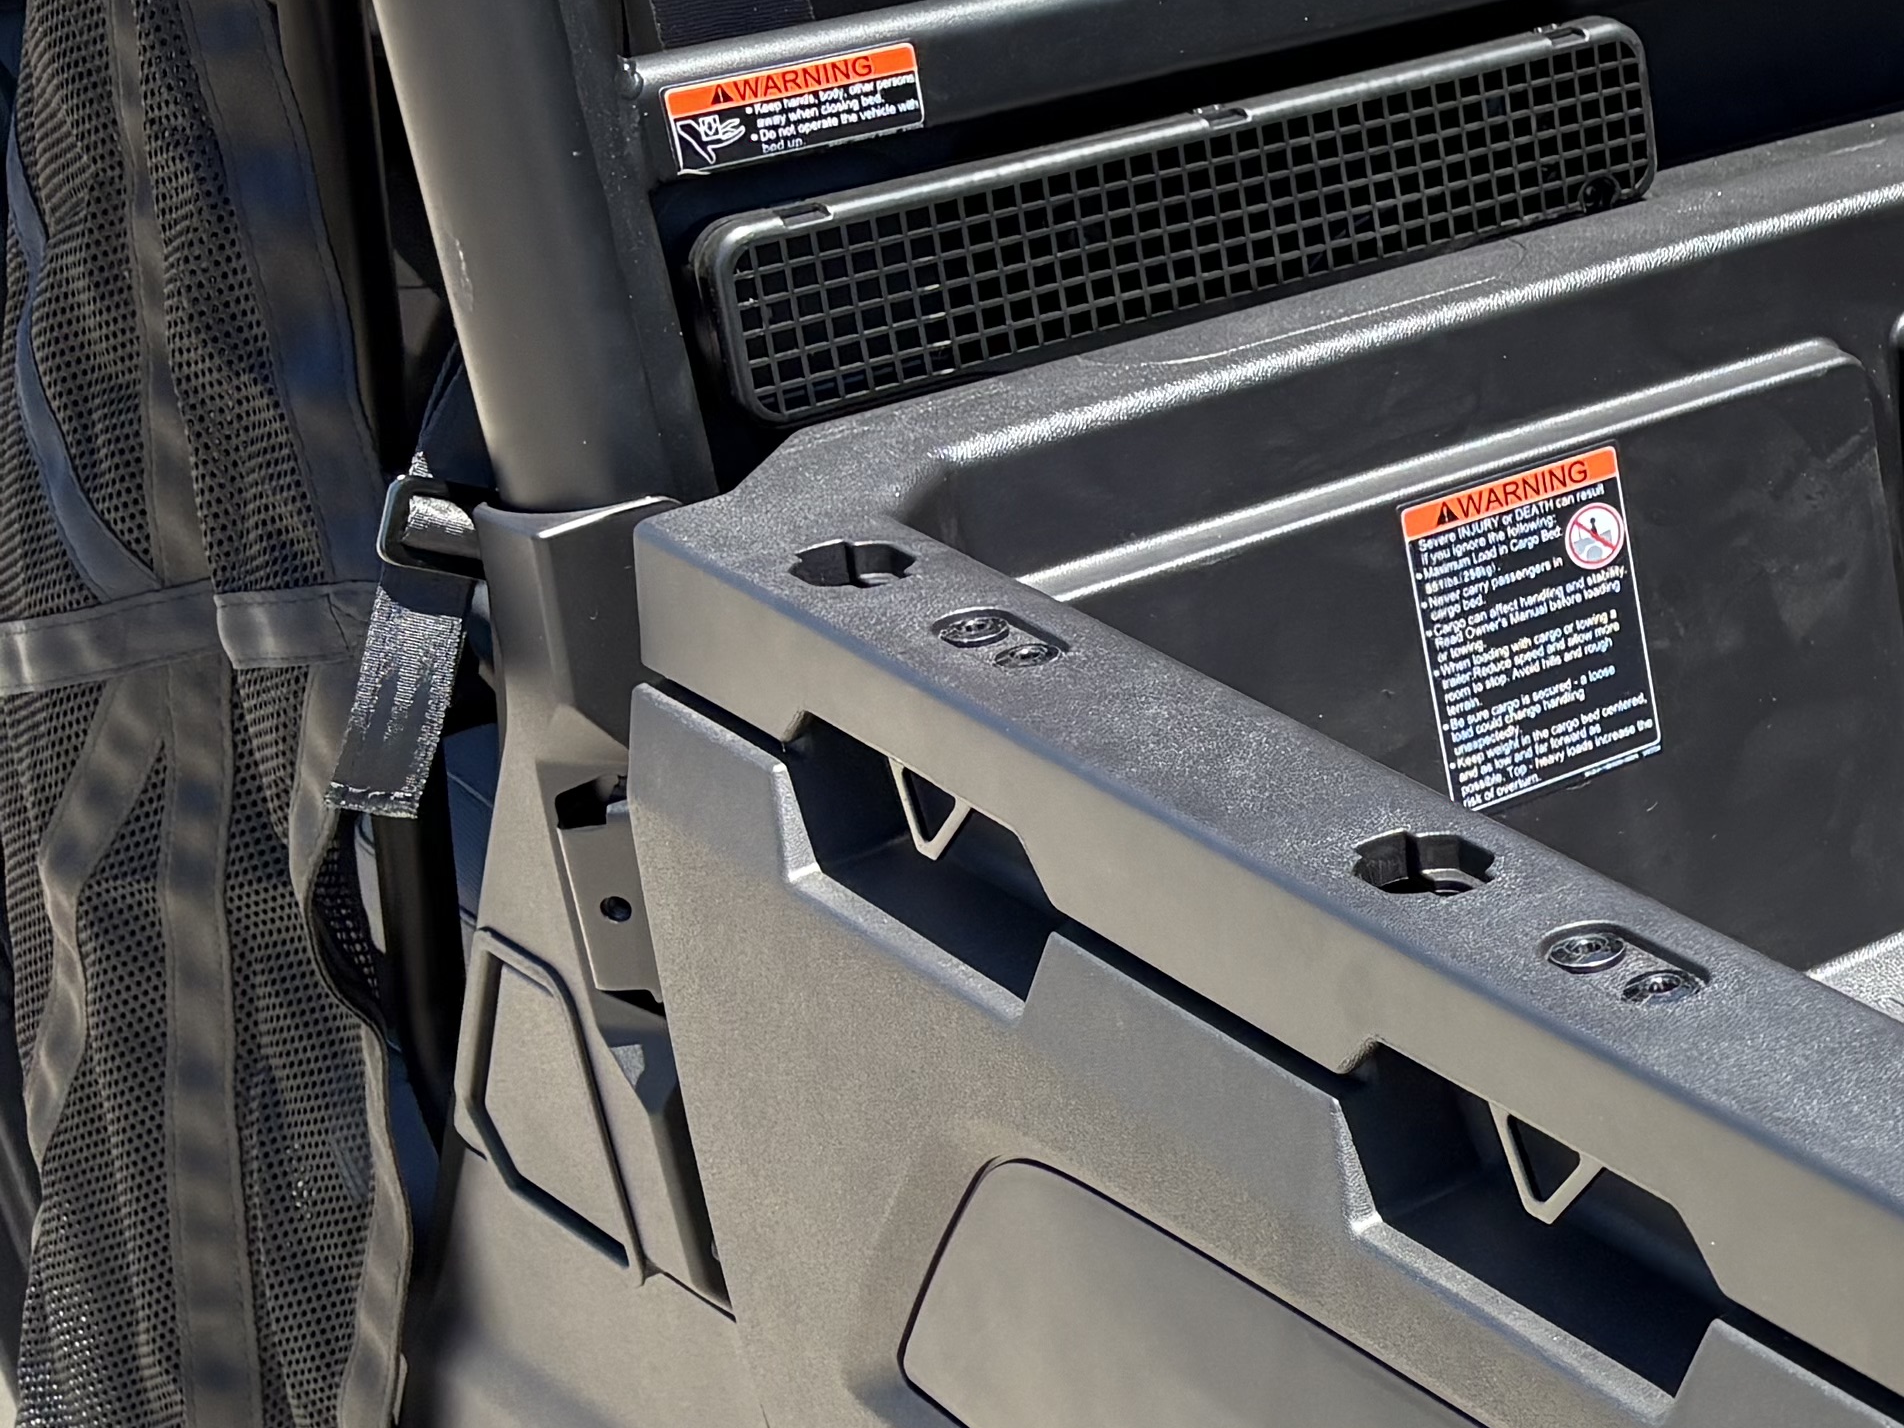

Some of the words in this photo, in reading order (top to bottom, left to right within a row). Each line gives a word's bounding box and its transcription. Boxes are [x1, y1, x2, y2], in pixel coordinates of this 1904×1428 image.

[733, 56, 871, 100] WARNING
[753, 101, 781, 114] Keep
[876, 74, 914, 91] persons
[759, 129, 776, 140] Do
[777, 124, 796, 136] not
[797, 116, 837, 133] operate
[839, 112, 857, 124] the
[858, 104, 896, 119] vehicle
[897, 99, 918, 112] with
[787, 106, 817, 120] when
[820, 98, 859, 114] closing
[761, 139, 784, 153] bed
[787, 137, 807, 150] up.
[1457, 460, 1586, 517] WARNING
[1418, 532, 1456, 551] Severe
[1457, 515, 1499, 539] INJURY
[1501, 513, 1512, 525] or
[1514, 499, 1553, 521] DEATH
[1555, 494, 1574, 508] can
[1576, 483, 1604, 502] result
[1429, 548, 1450, 564] you
[1451, 536, 1486, 556] ignore
[1487, 530, 1505, 544] the
[1506, 514, 1556, 537] following:
[1423, 556, 1471, 579] Maximum
[1471, 546, 1497, 564] Load
[1498, 544, 1508, 555] in
[1509, 534, 1539, 551] Cargo
[1427, 589, 1460, 608] Never
[1462, 581, 1488, 600] carry
[1490, 561, 1551, 590] passengers
[1552, 556, 1562, 567] in
[1430, 603, 1461, 621] cargo
[1433, 617, 1466, 639] Cargo
[1467, 611, 1487, 625] can
[1489, 599, 1518, 618] affect
[1519, 585, 1564, 607] handling
[1565, 577, 1584, 593] and
[1434, 630, 1463, 649] Read
[1464, 617, 1508, 639] Owner's
[1509, 602, 1547, 624] Manual
[1582, 579, 1620, 599] loading
[1437, 651, 1447, 663] or
[1449, 639, 1486, 658] towing.
[1439, 658, 1471, 675] When
[1471, 645, 1509, 668] loading
[1510, 636, 1531, 652] with
[1533, 627, 1562, 644] cargo
[1563, 623, 1573, 634] or
[1575, 611, 1607, 630] towing
[1513, 645, 1544, 665] speed
[1546, 638, 1565, 654] and
[1594, 622, 1619, 637] more
[1444, 686, 1471, 703] room
[1471, 682, 1483, 693] to
[1512, 660, 1540, 680] Avoid
[1541, 654, 1561, 669] hills
[1563, 646, 1582, 662] and
[1583, 637, 1612, 654] rough
[1446, 697, 1482, 716] terrain.
[1449, 717, 1464, 730] Be
[1466, 709, 1489, 724] sure
[1490, 699, 1519, 719] cargo
[1520, 694, 1530, 705] is
[1532, 678, 1571, 701] secured
[1588, 665, 1615, 681] loose
[1450, 725, 1474, 742] load
[1475, 715, 1503, 734] could
[1504, 703, 1541, 726] change
[1542, 688, 1585, 710] handling
[1456, 751, 1484, 768] Keep
[1485, 737, 1519, 758] weight
[1520, 734, 1531, 746] in
[1532, 728, 1549, 741] the
[1550, 718, 1579, 738] cargo
[1580, 708, 1600, 724] bed
[1458, 766, 1478, 782] and
[1480, 763, 1493, 774] as
[1493, 755, 1511, 768] low
[1514, 746, 1533, 762] and
[1534, 742, 1548, 755] far
[1549, 727, 1587, 749] forward
[1588, 724, 1601, 735] as
[1506, 764, 1527, 778] Top
[1534, 750, 1564, 769] heavy
[1565, 740, 1593, 757] loads
[1594, 724, 1635, 746] increase
[1636, 718, 1652, 731] the
[1462, 793, 1482, 807] risk
[1483, 787, 1494, 800] of
[1495, 773, 1541, 796] overturn.
